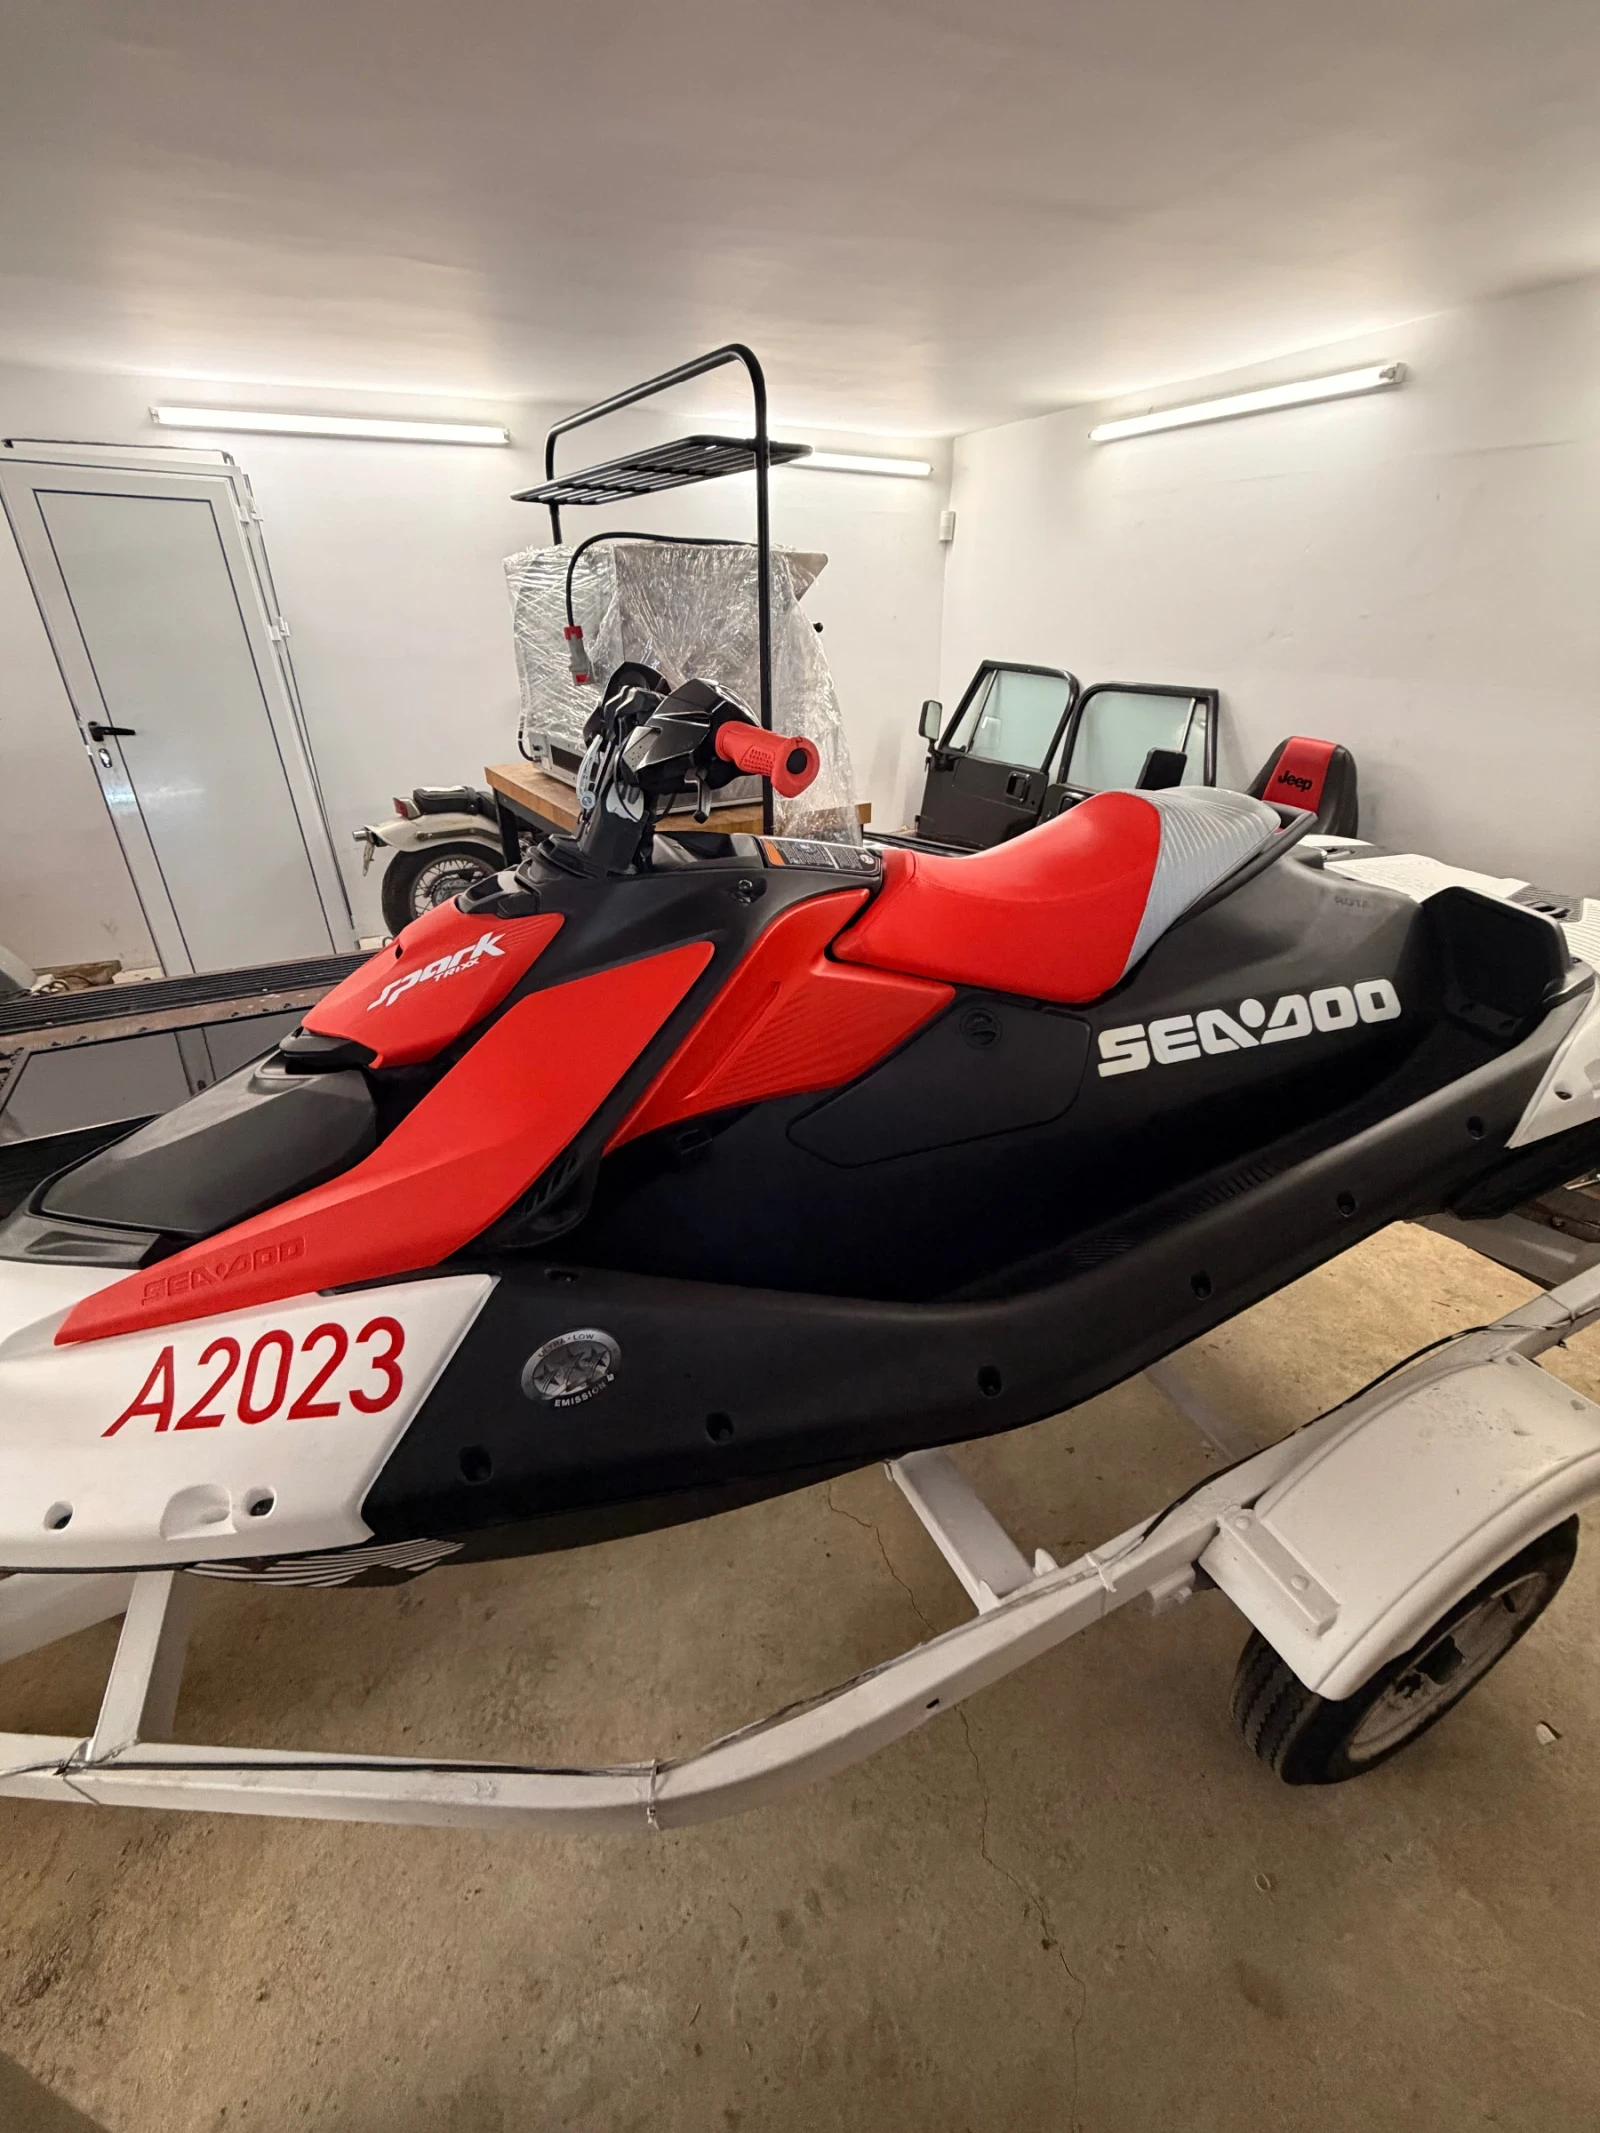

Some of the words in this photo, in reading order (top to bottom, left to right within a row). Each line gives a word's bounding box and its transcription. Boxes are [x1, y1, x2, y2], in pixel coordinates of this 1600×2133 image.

[1277, 770, 1313, 792] Jeep
[433, 957, 480, 982] TRIXX
[573, 1333, 595, 1341] LOW
[100, 1316, 405, 1438] A2023
